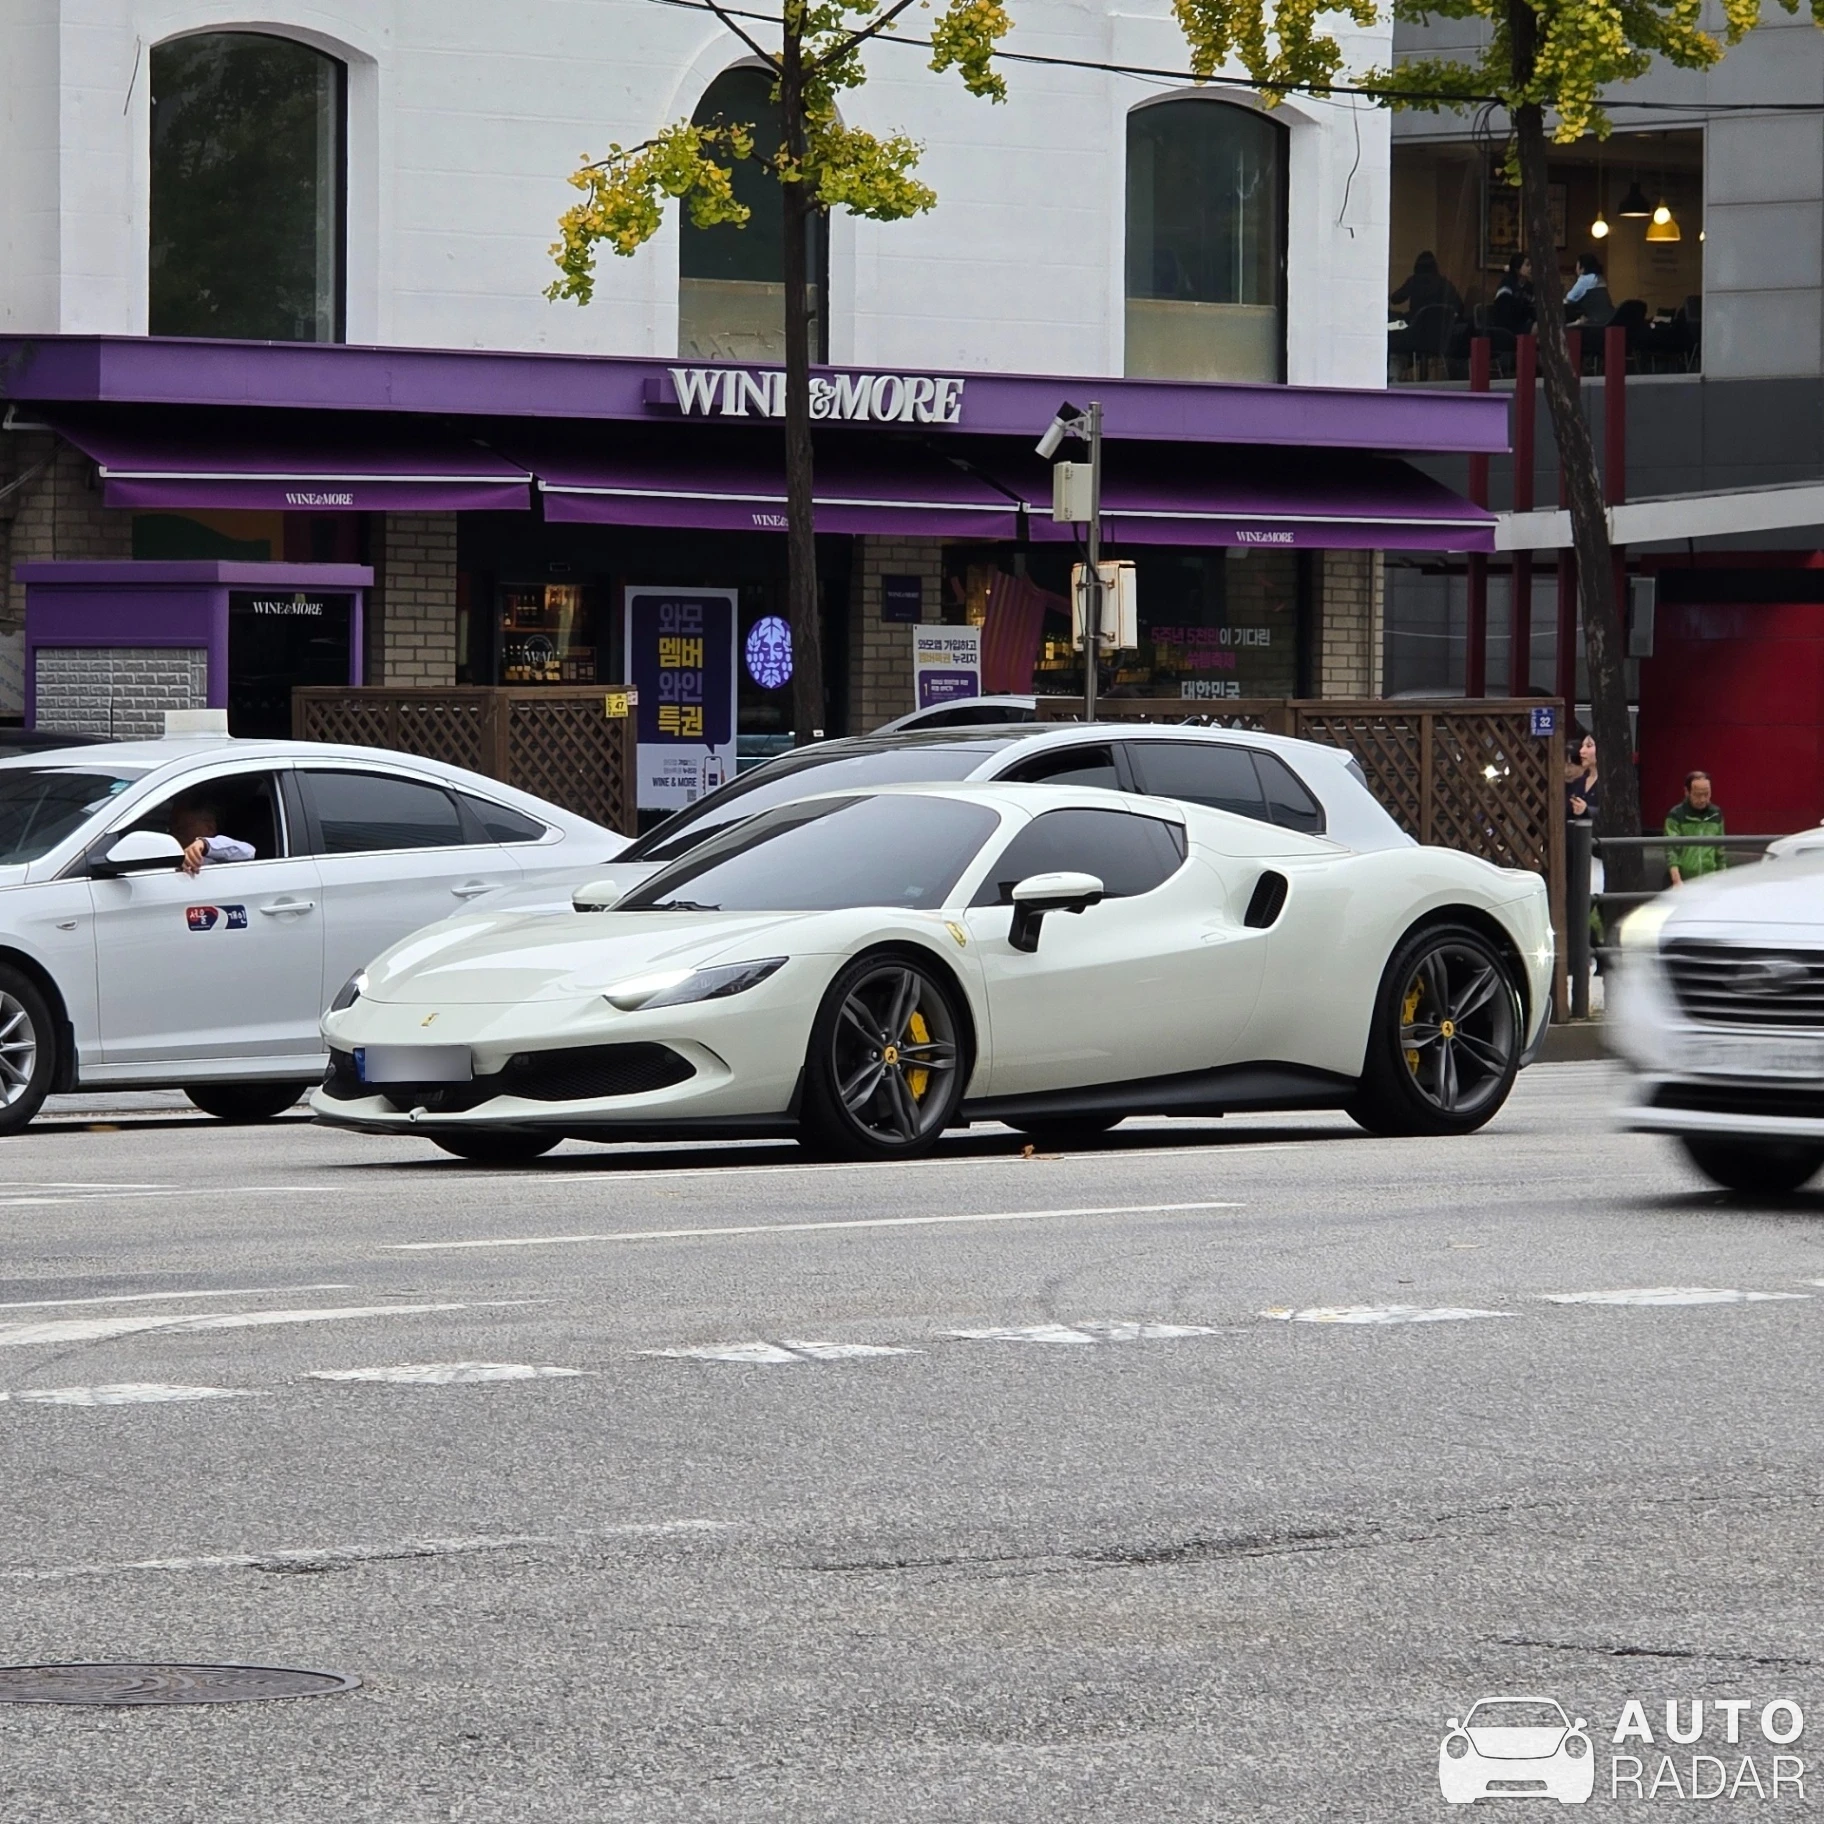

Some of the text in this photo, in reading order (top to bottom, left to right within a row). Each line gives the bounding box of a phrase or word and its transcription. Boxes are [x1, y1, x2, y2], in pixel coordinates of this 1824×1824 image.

[285, 493, 354, 505] WINE&MORE
[1236, 531, 1294, 543] WINE&MORE
[252, 601, 323, 616] WINE&MORE
[658, 603, 703, 633] 와모
[1234, 628, 1270, 646] 기다린
[944, 639, 977, 651] 가입하고
[658, 637, 703, 668] 멤버
[952, 653, 977, 664] 누리자
[658, 671, 703, 702] 와인
[1181, 680, 1241, 700] 대한민국
[615, 701, 625, 710] 47
[658, 705, 703, 736] 특권
[1539, 716, 1551, 728] 32
[652, 777, 670, 787] WINE
[671, 777, 677, 787] &
[678, 777, 697, 787] MORE
